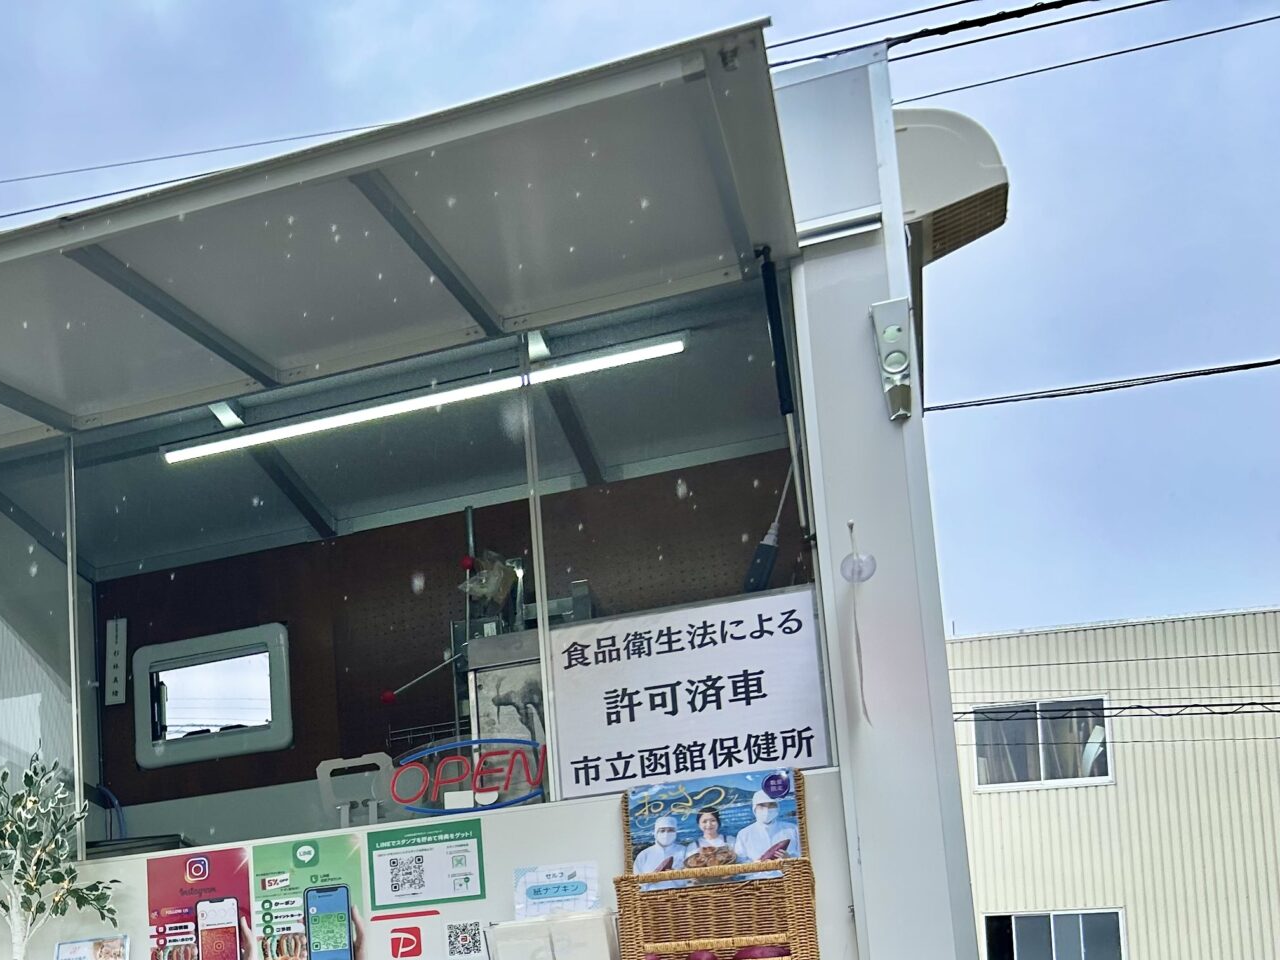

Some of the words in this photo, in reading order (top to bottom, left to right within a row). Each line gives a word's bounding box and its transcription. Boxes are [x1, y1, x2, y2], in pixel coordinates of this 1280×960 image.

[562, 609, 803, 669] 食品衛生法による
[604, 669, 767, 725] 許可済車
[390, 744, 547, 804] OPEN
[571, 727, 814, 786] 市立函館保健所
[180, 886, 216, 897] Instagram
